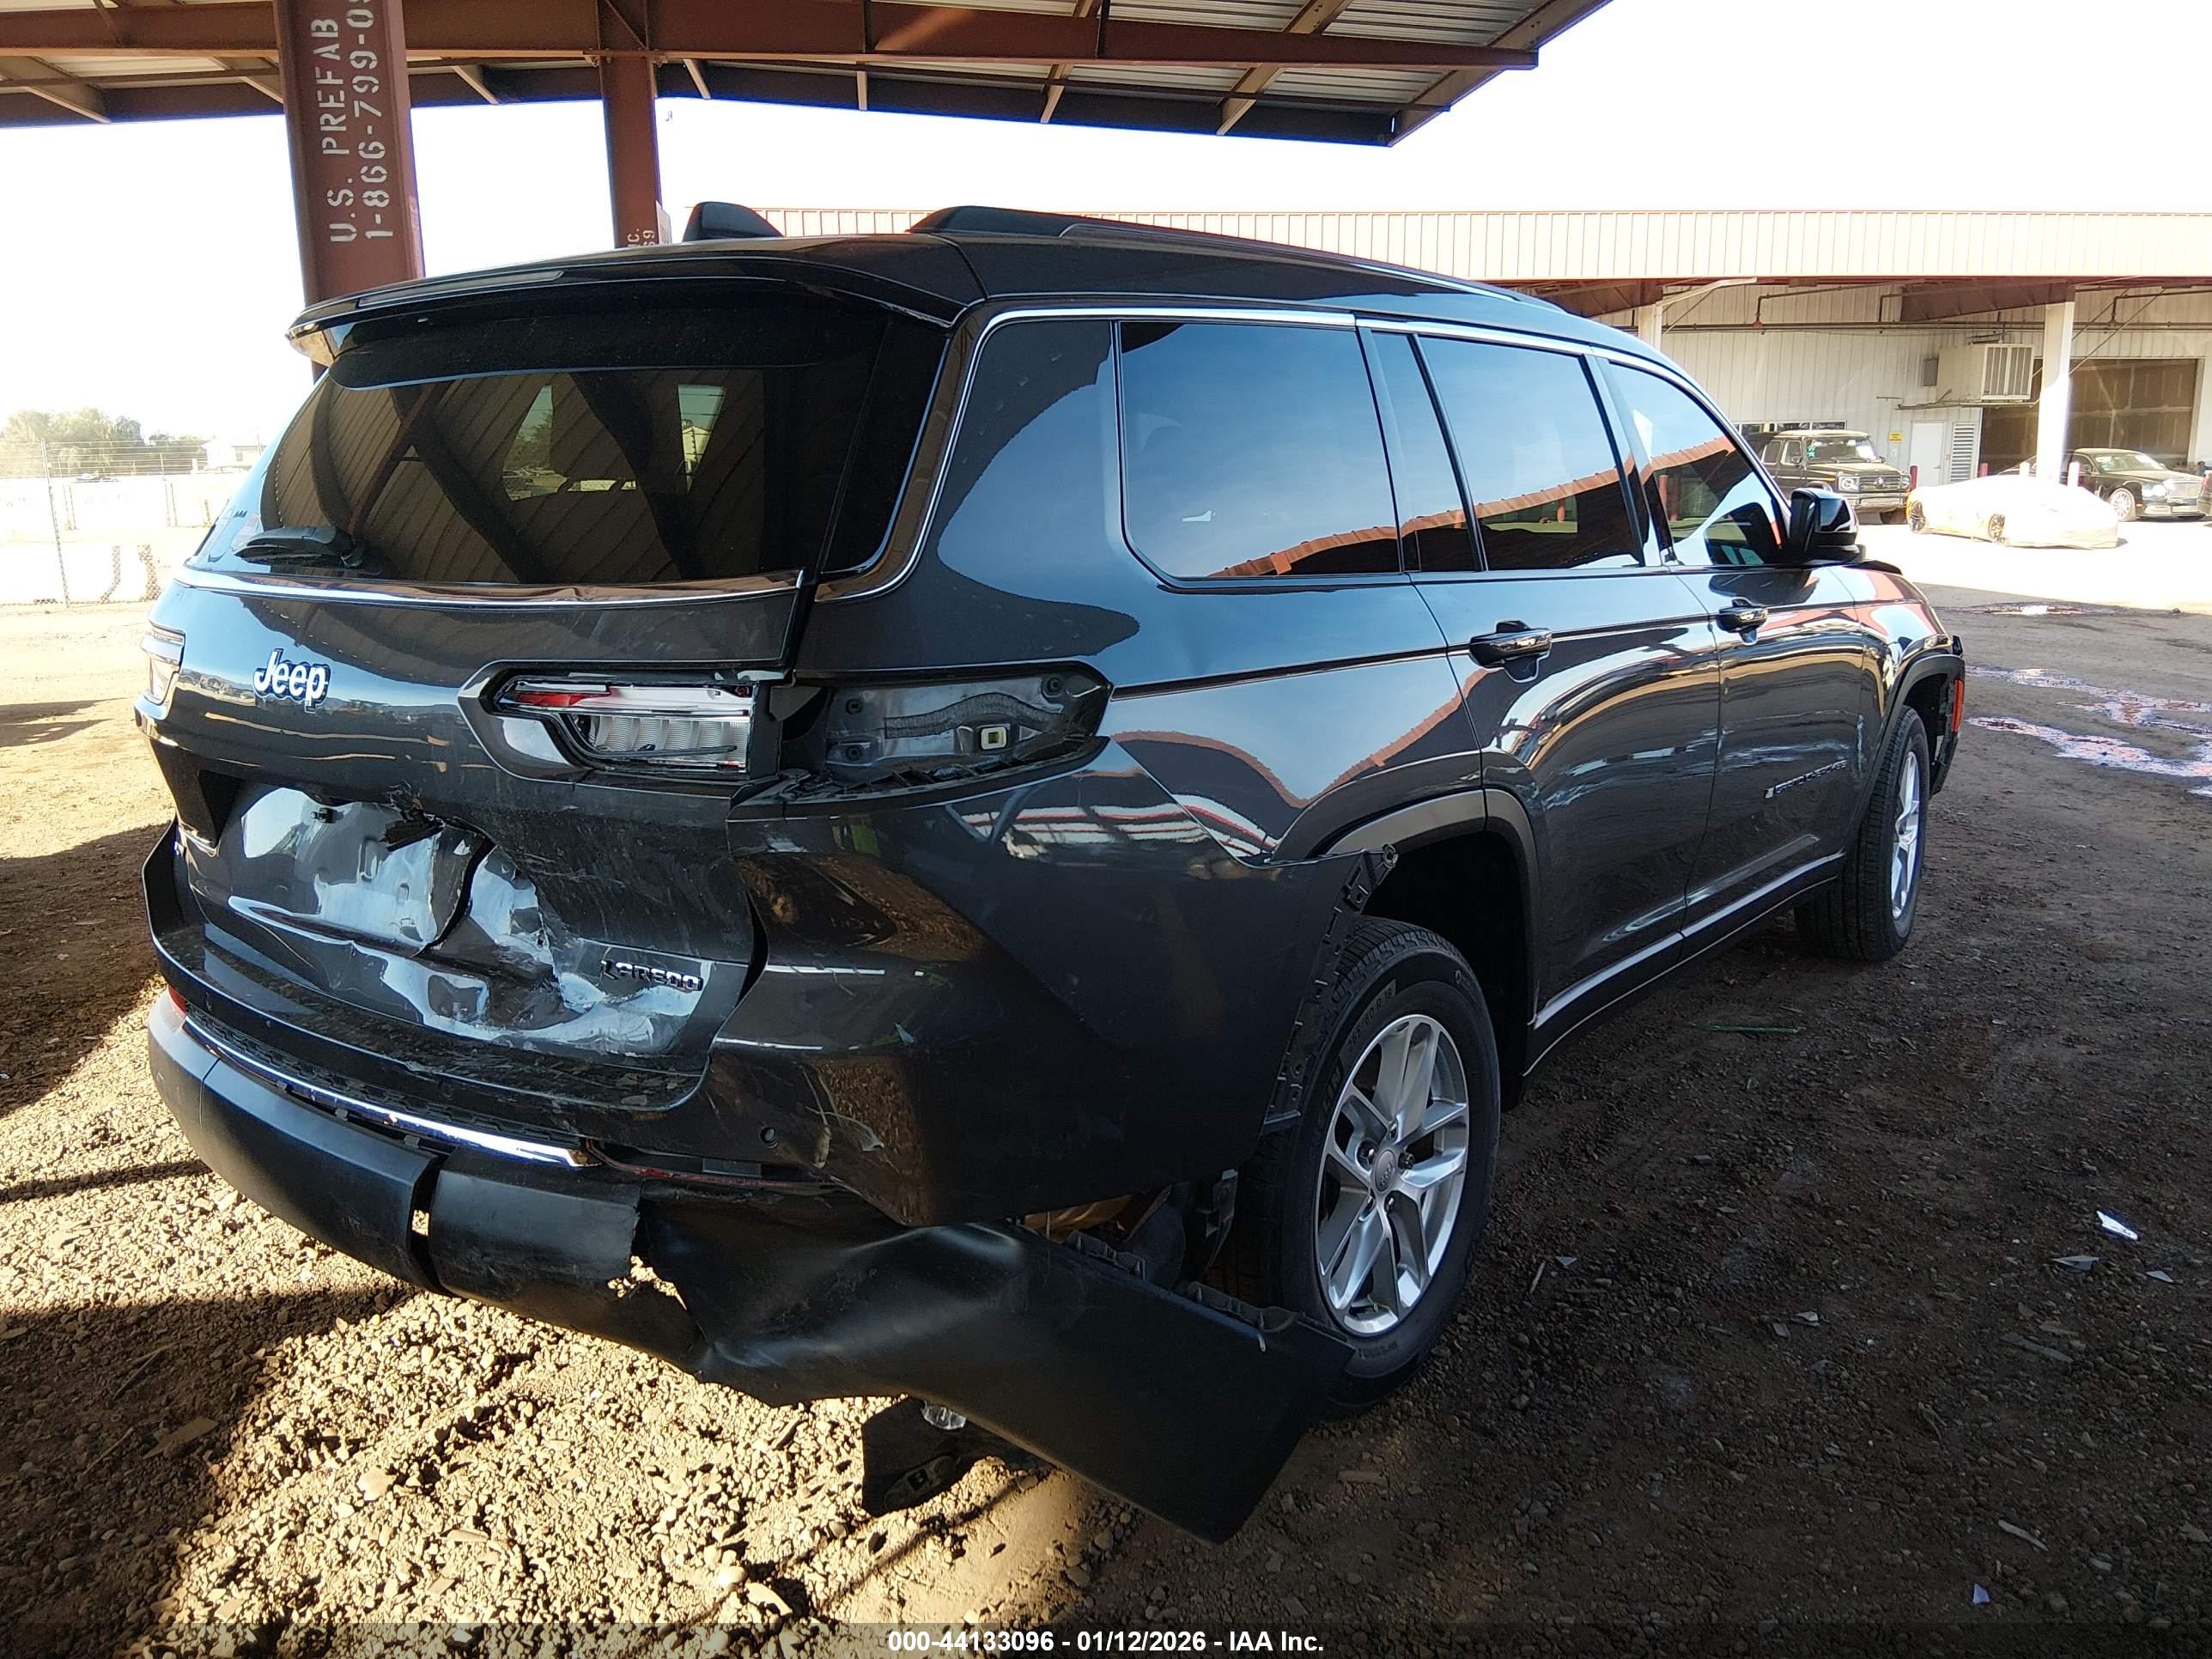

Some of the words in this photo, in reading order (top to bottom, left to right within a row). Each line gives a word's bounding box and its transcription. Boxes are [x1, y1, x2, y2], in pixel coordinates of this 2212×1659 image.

[310, 18, 350, 155] PREFAB
[346, 0, 394, 240] 1-866-799-0
[327, 177, 358, 242] U.S.
[253, 648, 331, 711] Jeep
[600, 959, 704, 992] LAREDO
